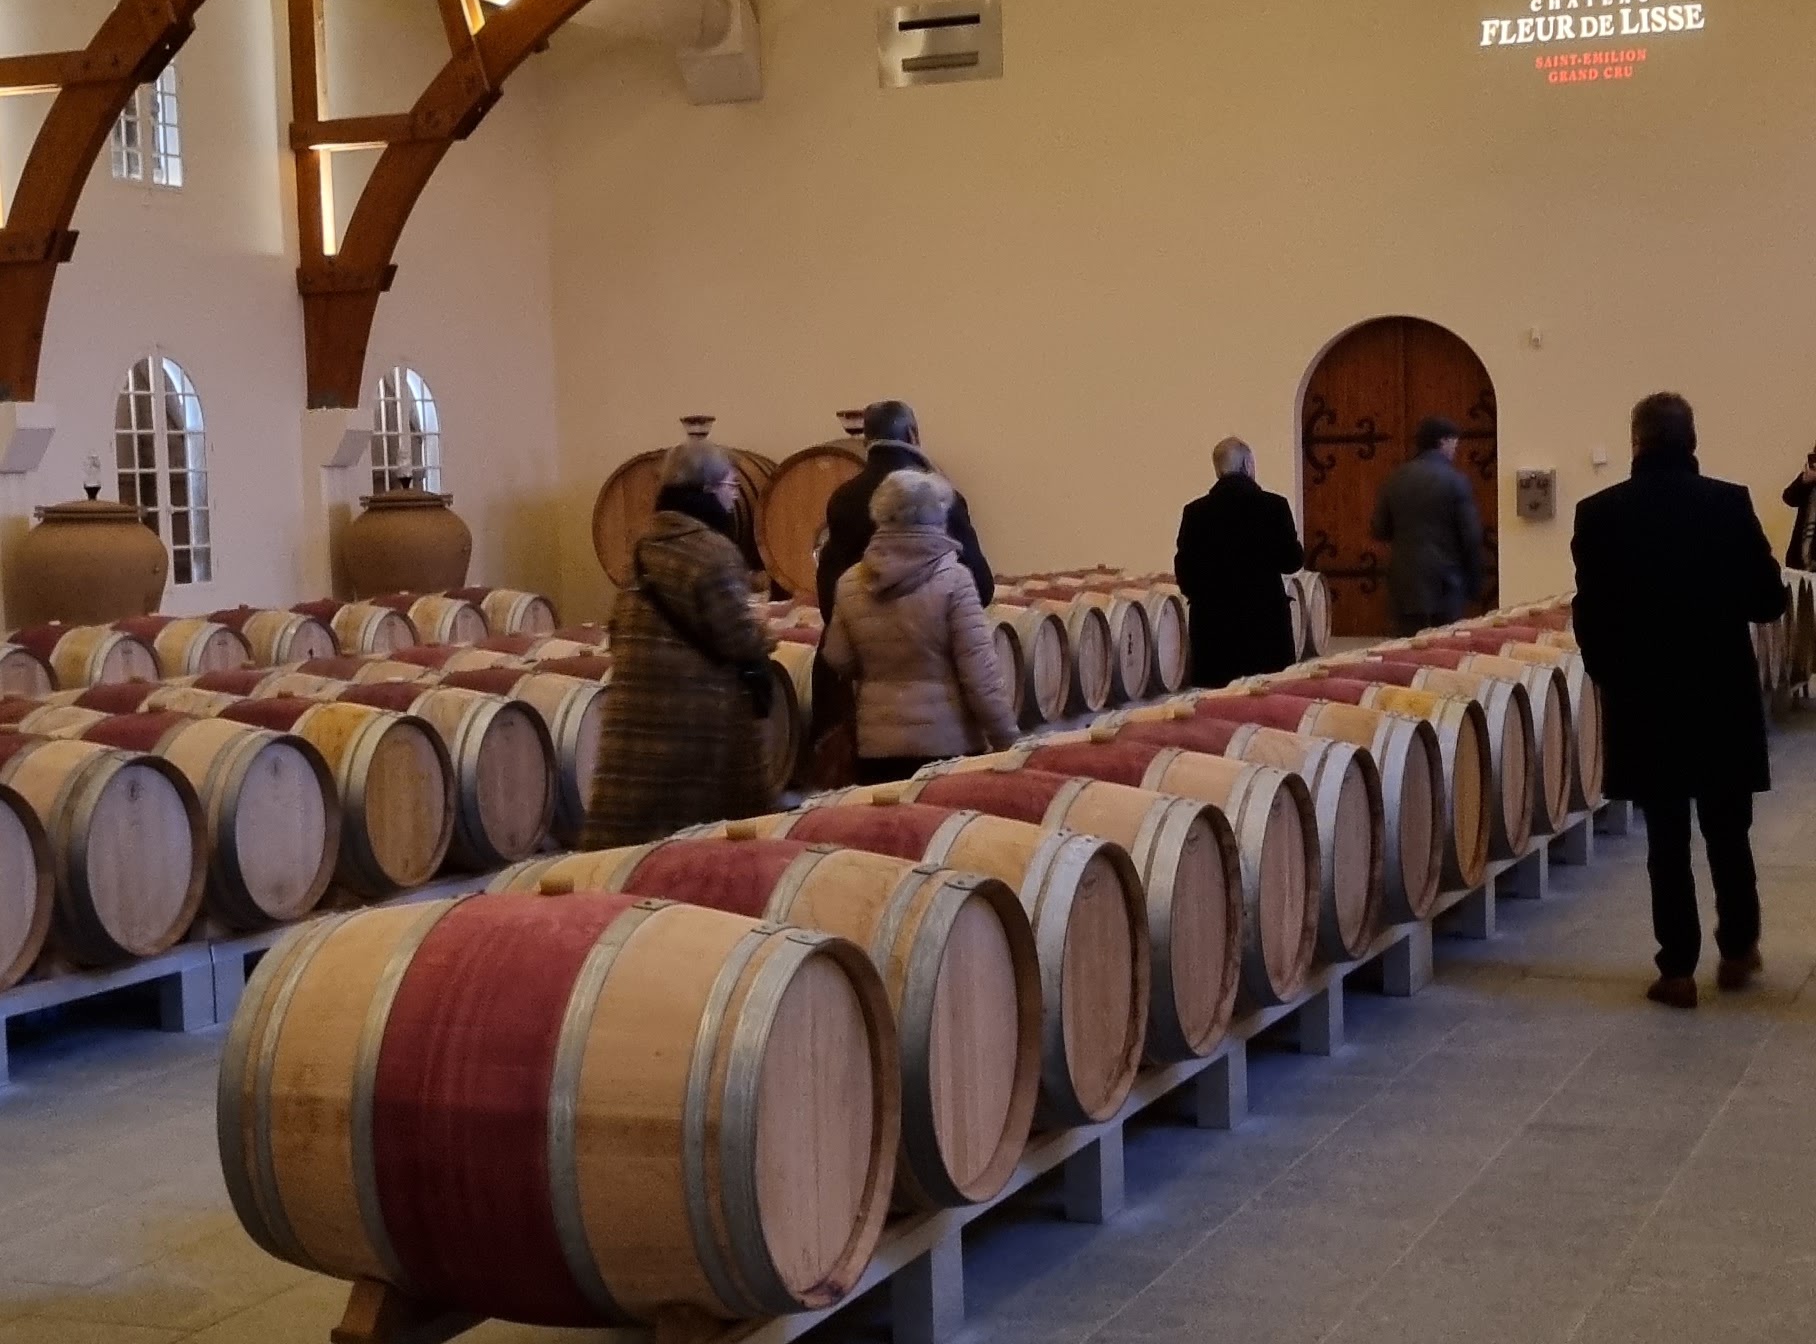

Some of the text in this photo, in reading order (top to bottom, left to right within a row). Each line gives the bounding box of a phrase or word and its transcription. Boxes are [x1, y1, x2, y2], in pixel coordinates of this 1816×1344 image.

[1479, 4, 1705, 46] FLEUR DE LISSE
[1548, 66, 1633, 83] GRAND CRU
